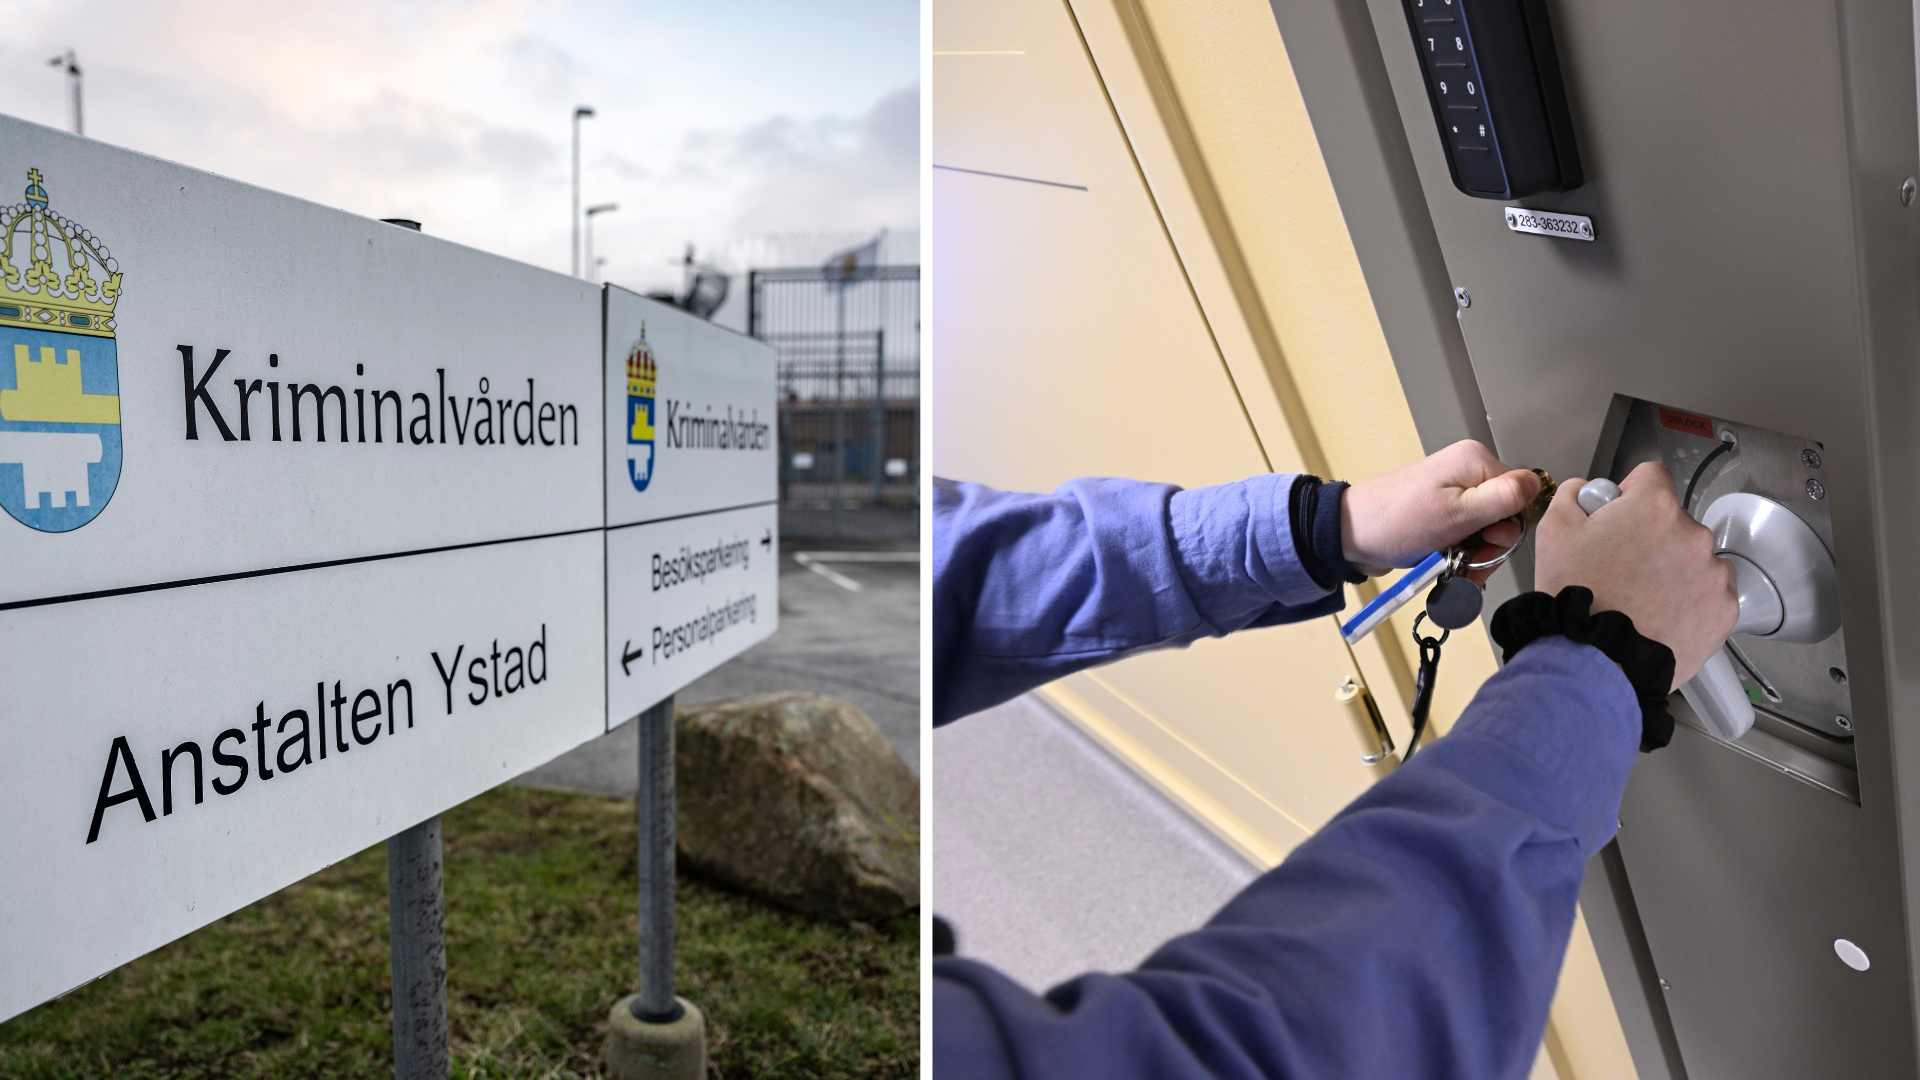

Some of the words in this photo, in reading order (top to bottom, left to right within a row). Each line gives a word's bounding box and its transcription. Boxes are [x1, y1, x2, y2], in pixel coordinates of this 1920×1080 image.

[1427, 37, 1434, 51] 7
[1455, 36, 1463, 51] 8
[1440, 81, 1447, 94] 9
[1467, 81, 1475, 95] 0
[1518, 214, 1579, 234] 283-363232
[176, 344, 580, 446] Kriminalvården
[666, 399, 769, 450] Kriminalvården
[1666, 413, 1706, 431] UNLOCK
[652, 536, 749, 592] Besöksparkering
[652, 592, 756, 665] Personalparkering
[86, 677, 414, 845] Anstalten
[431, 623, 548, 715] Ystad
